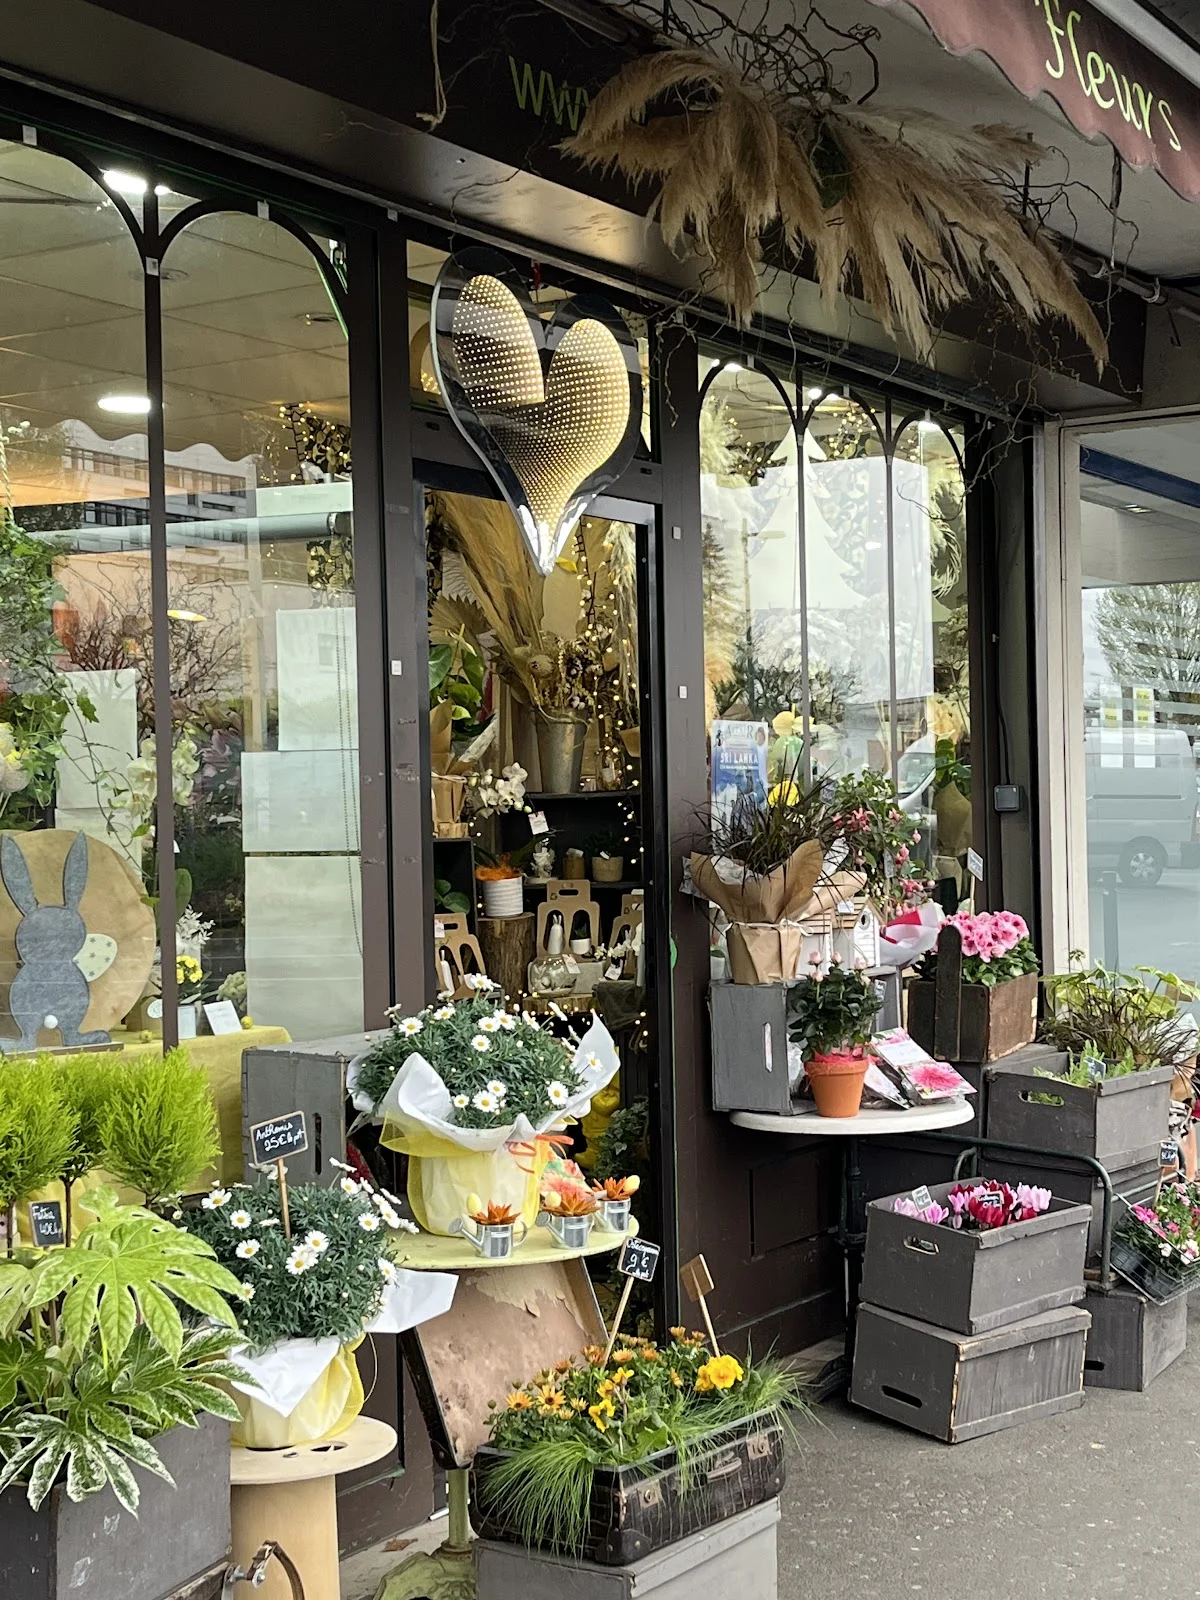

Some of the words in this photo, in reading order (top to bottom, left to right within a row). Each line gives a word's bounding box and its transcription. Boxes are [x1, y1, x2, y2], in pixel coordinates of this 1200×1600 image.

[508, 54, 590, 132] ww
[1034, 0, 1182, 151] Fleurs
[720, 752, 732, 764] SRI
[733, 752, 758, 764] LANKA
[625, 1253, 638, 1271] 9
